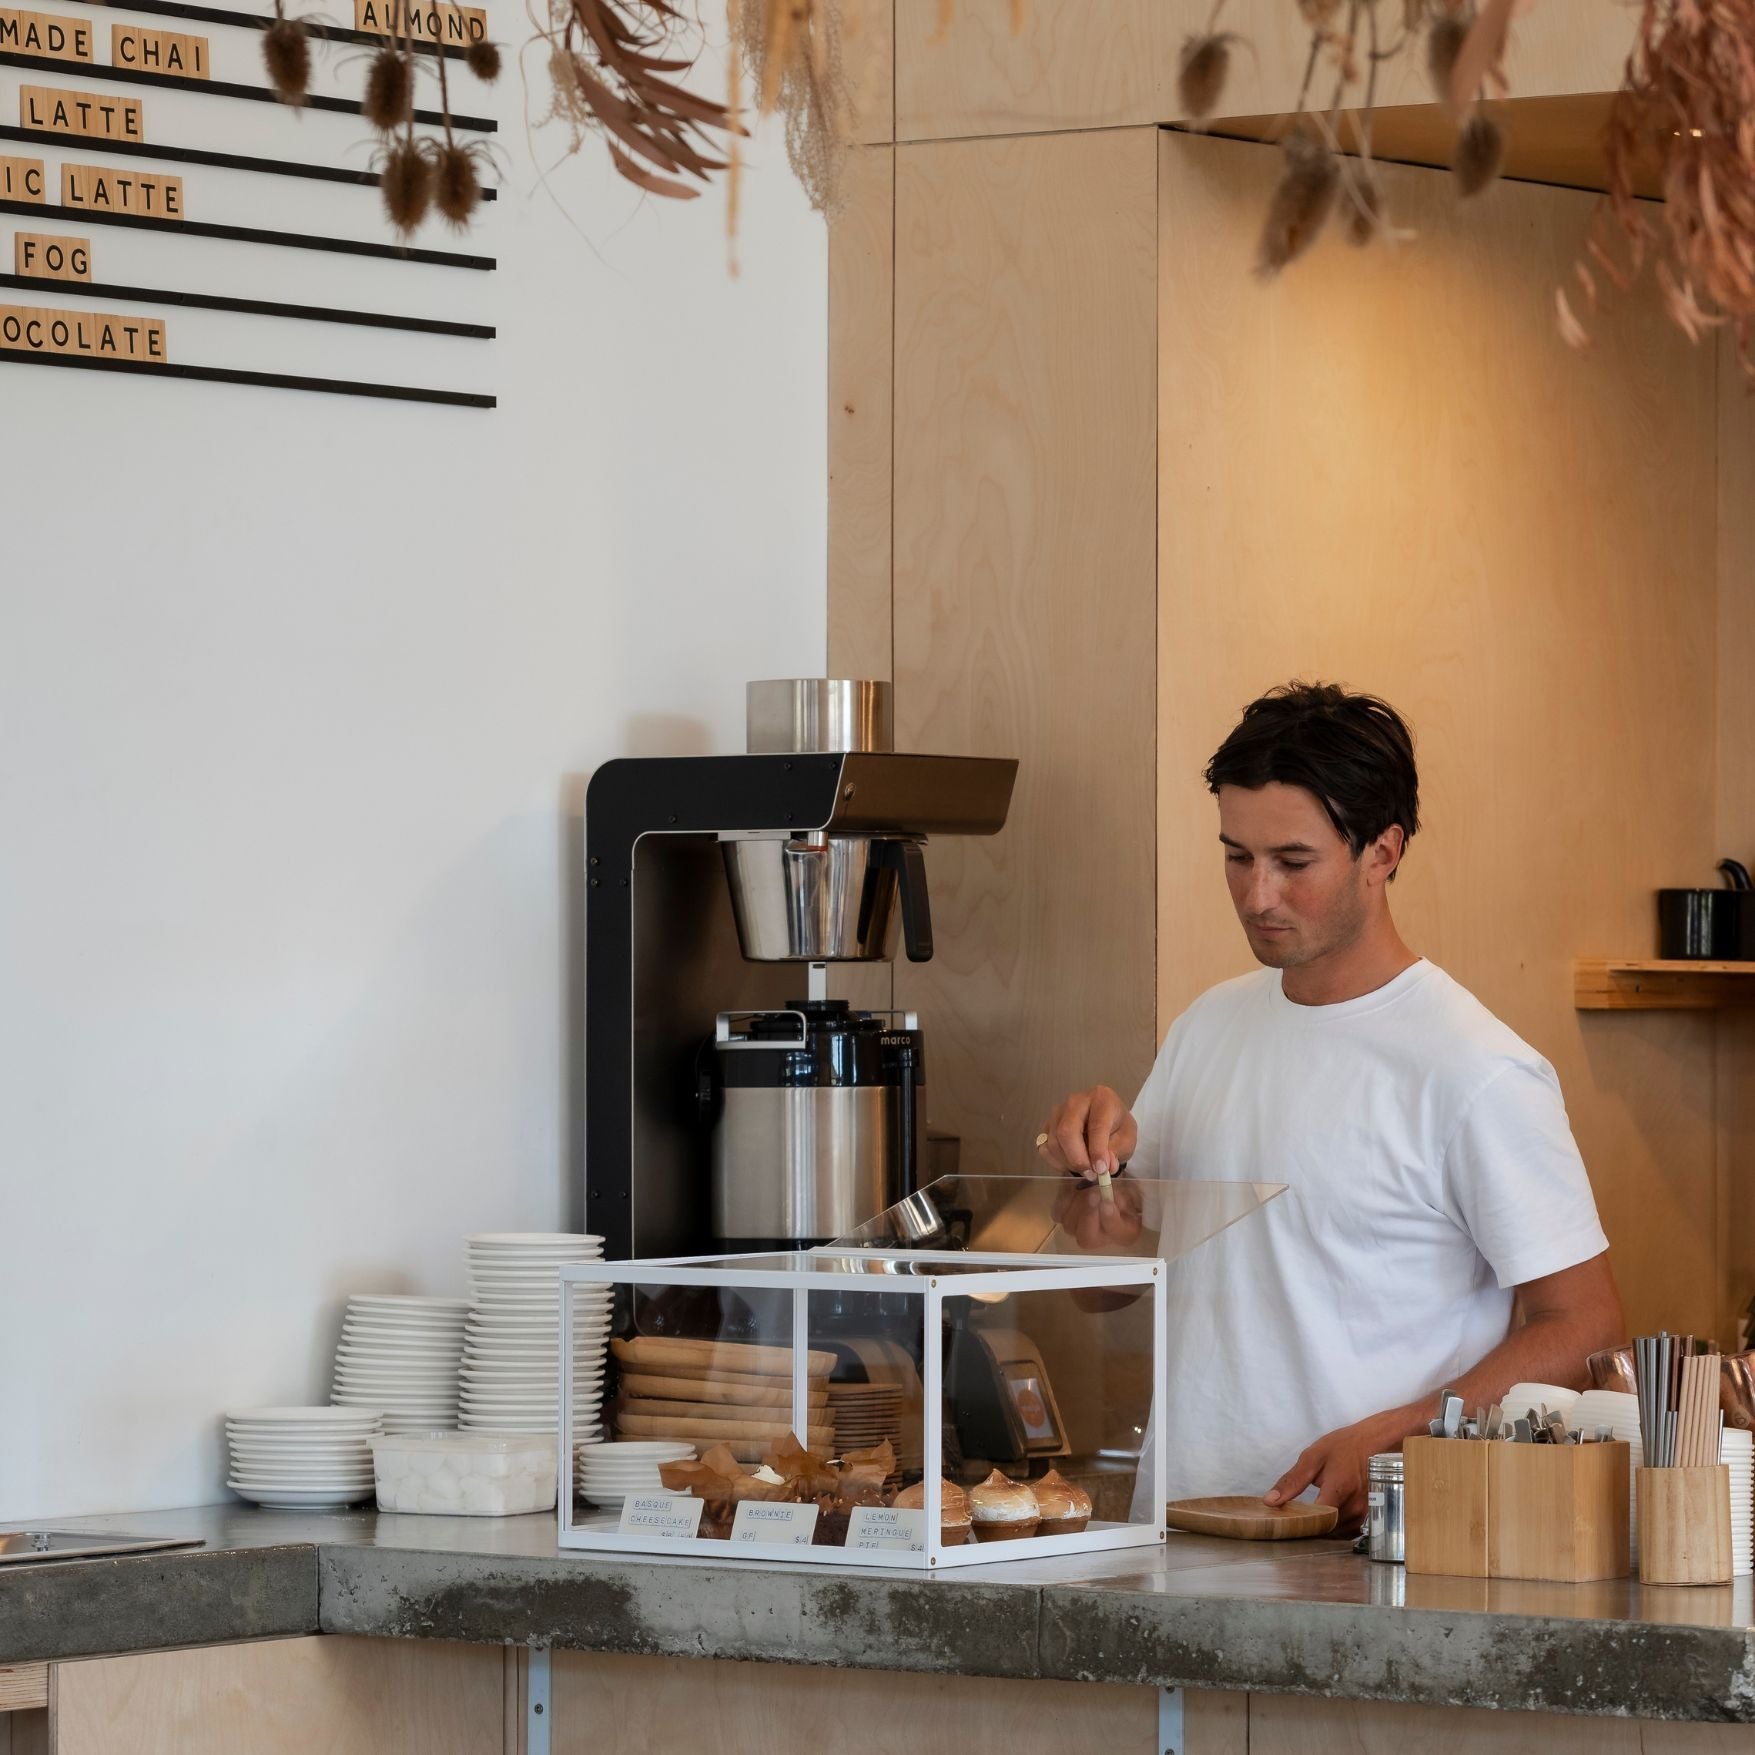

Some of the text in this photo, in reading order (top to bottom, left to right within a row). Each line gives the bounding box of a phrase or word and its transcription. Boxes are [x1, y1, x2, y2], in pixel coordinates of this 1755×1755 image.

[363, 1, 485, 43] ALMOND
[0, 18, 200, 72] MADE CHAI
[30, 97, 138, 135] LATTE
[70, 174, 178, 213] LATTE
[24, 242, 87, 274] FOG
[3, 316, 161, 355] OCOLATE
[880, 1036, 911, 1045] marco
[634, 1500, 671, 1509] BASQUE
[748, 1509, 792, 1519] BROWNIE
[630, 1515, 689, 1527] CHEESECAKE
[865, 1512, 896, 1522] LEMON
[861, 1527, 911, 1538] MERINGUE
